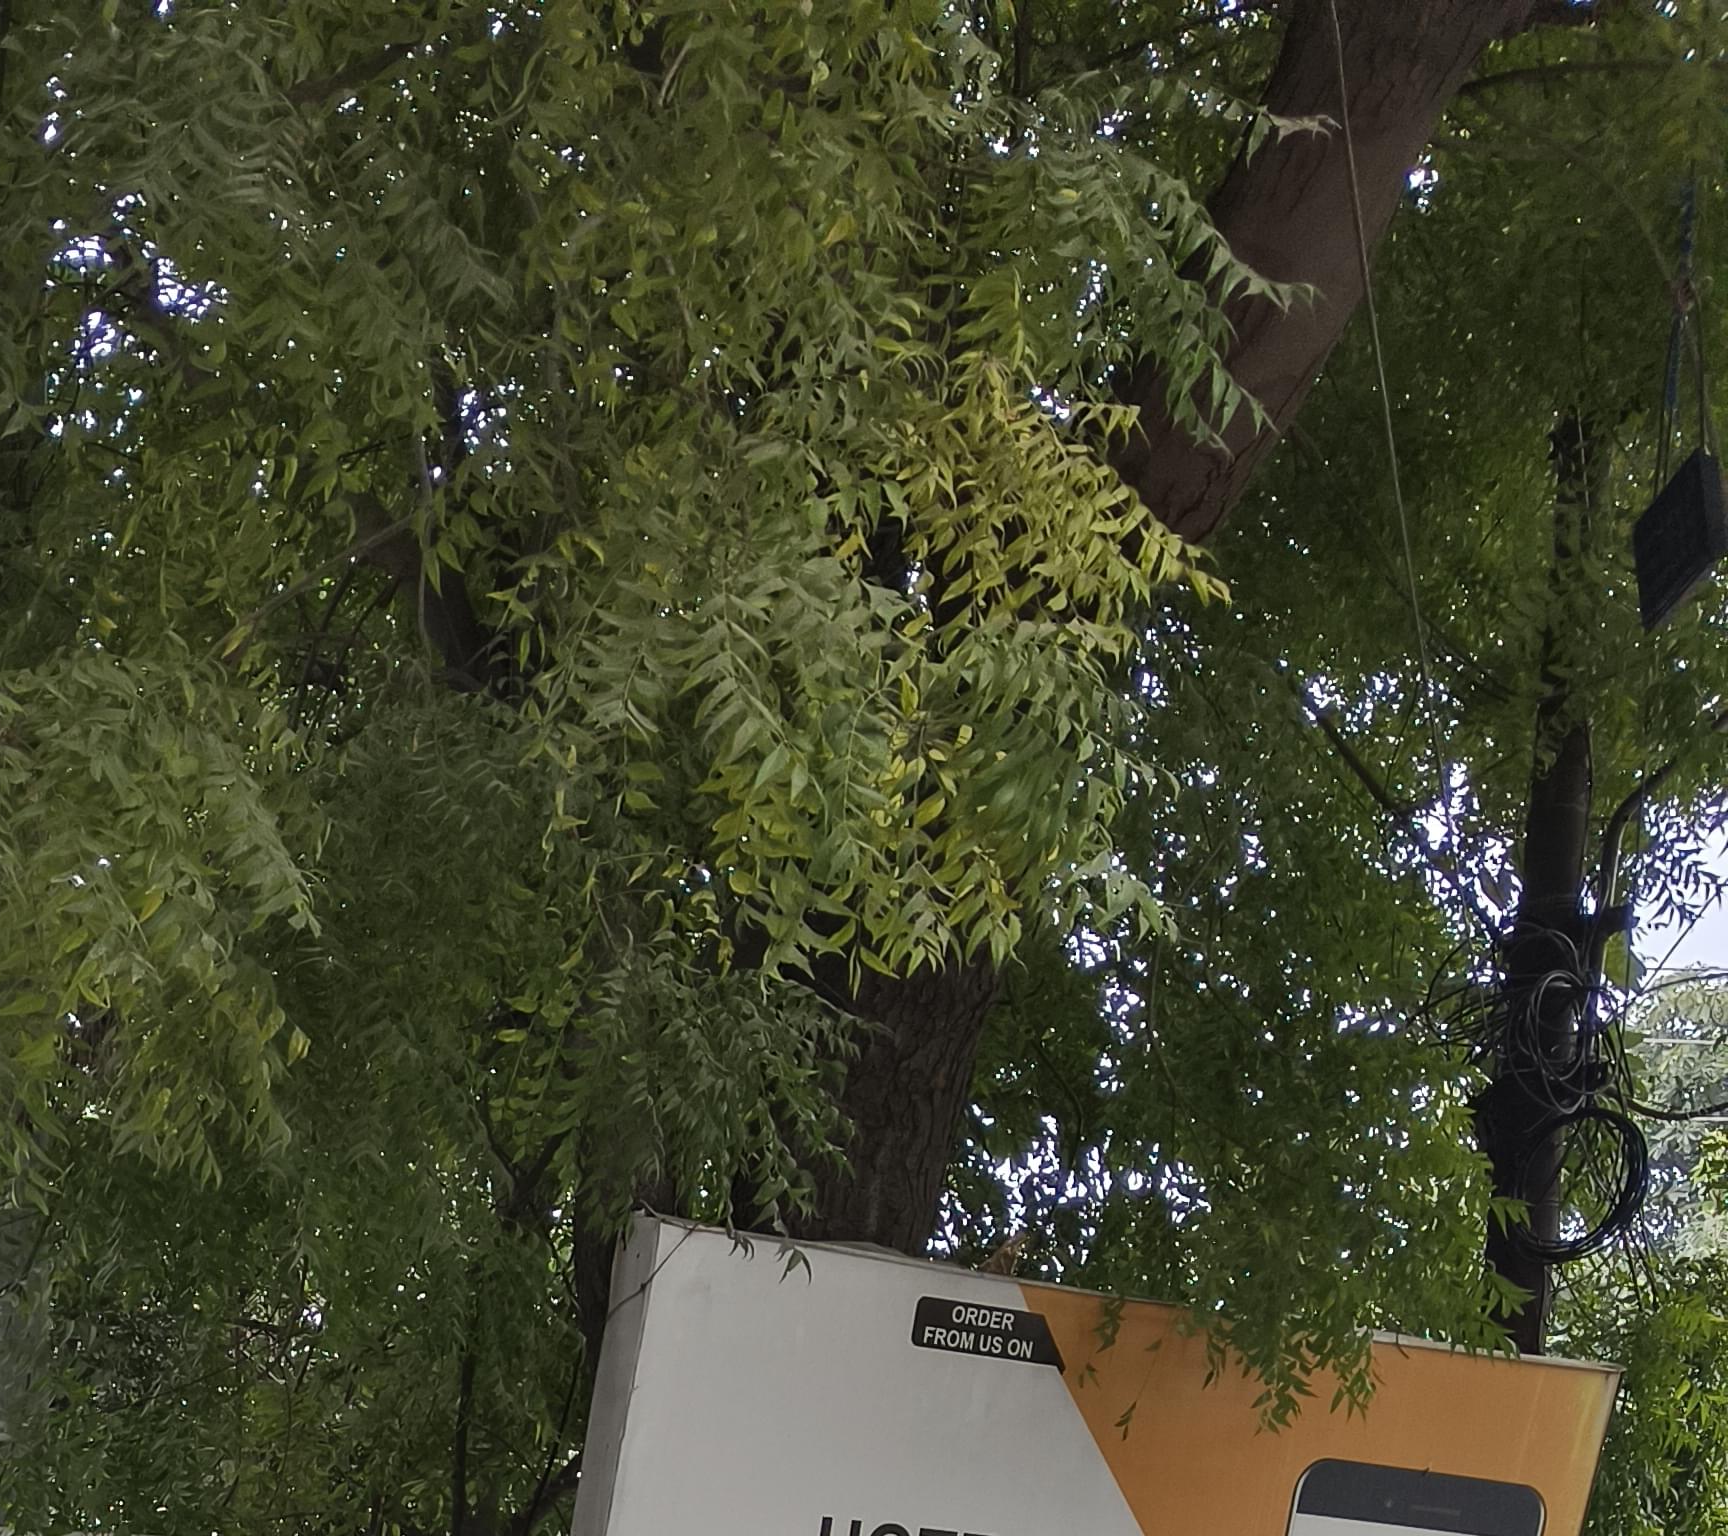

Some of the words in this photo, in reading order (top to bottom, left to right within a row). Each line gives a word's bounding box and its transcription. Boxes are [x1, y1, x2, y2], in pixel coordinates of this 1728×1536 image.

[952, 1306, 1014, 1331] ORDER
[923, 1326, 974, 1350] FROM
[979, 1335, 1003, 1354] US
[1007, 1339, 1033, 1358] ON
